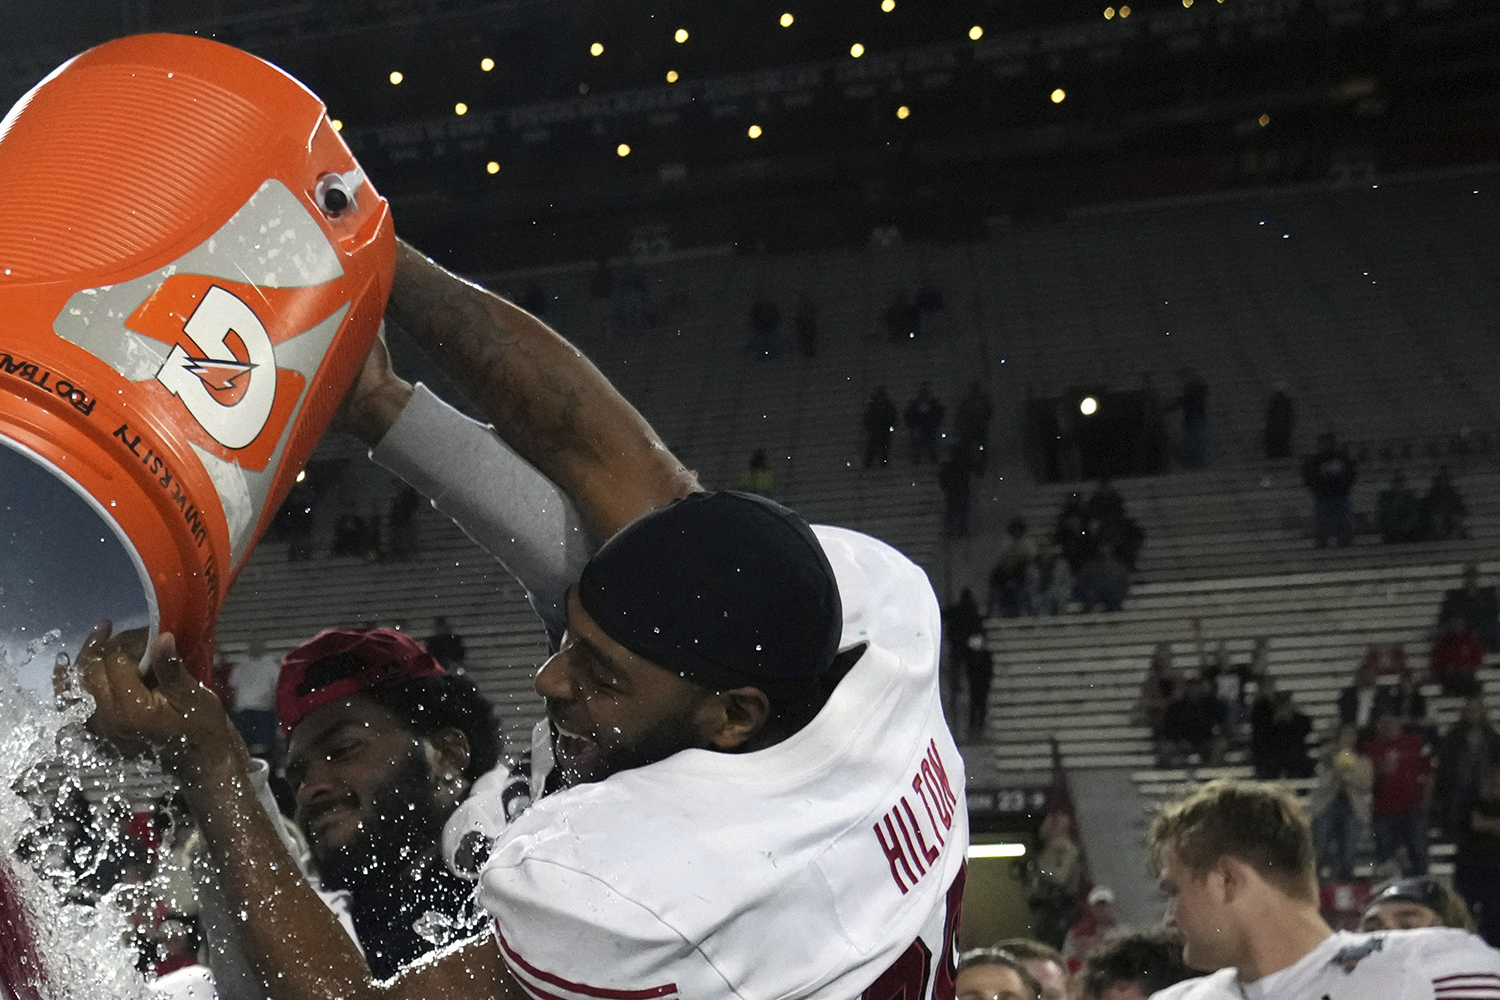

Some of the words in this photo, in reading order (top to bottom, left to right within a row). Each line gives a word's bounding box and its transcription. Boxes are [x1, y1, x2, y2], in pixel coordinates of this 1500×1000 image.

[155, 284, 277, 450] G
[112, 423, 207, 548] UNIVERSITY
[873, 738, 957, 895] HILTON
